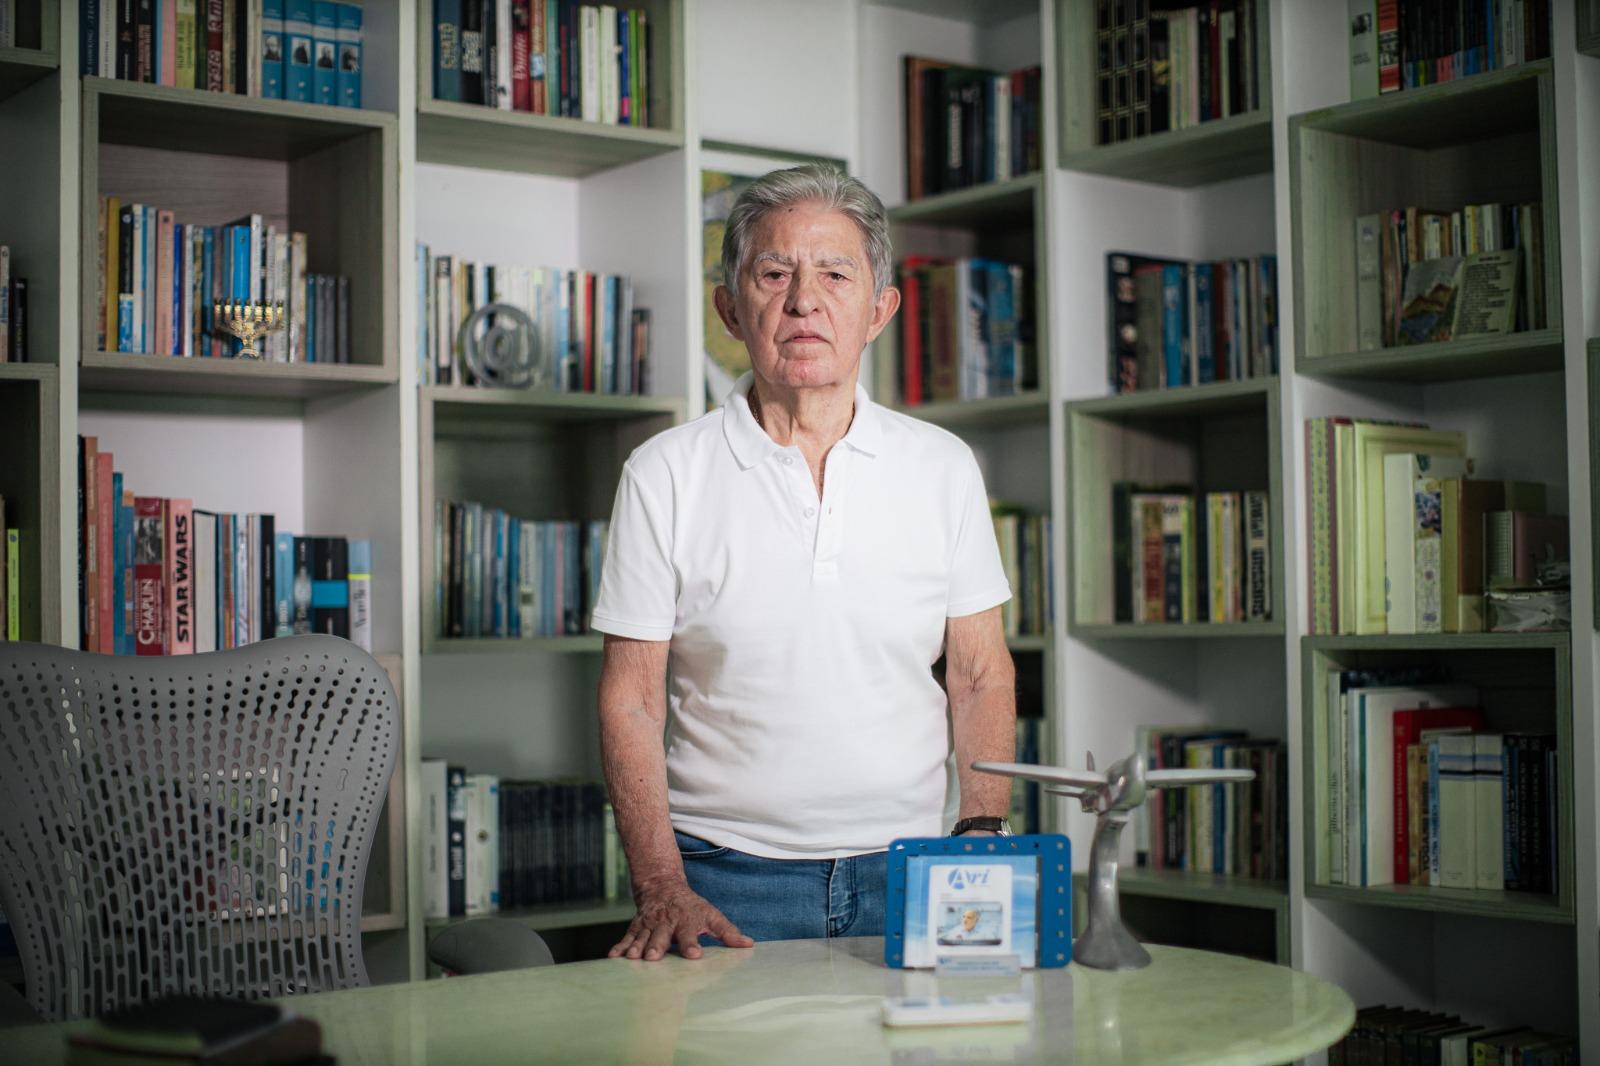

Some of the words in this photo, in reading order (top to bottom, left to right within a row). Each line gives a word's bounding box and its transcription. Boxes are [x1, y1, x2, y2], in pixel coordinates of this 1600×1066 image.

[175, 513, 188, 582] WARS
[138, 579, 155, 645] CHAPLIN
[176, 584, 189, 643] STAR
